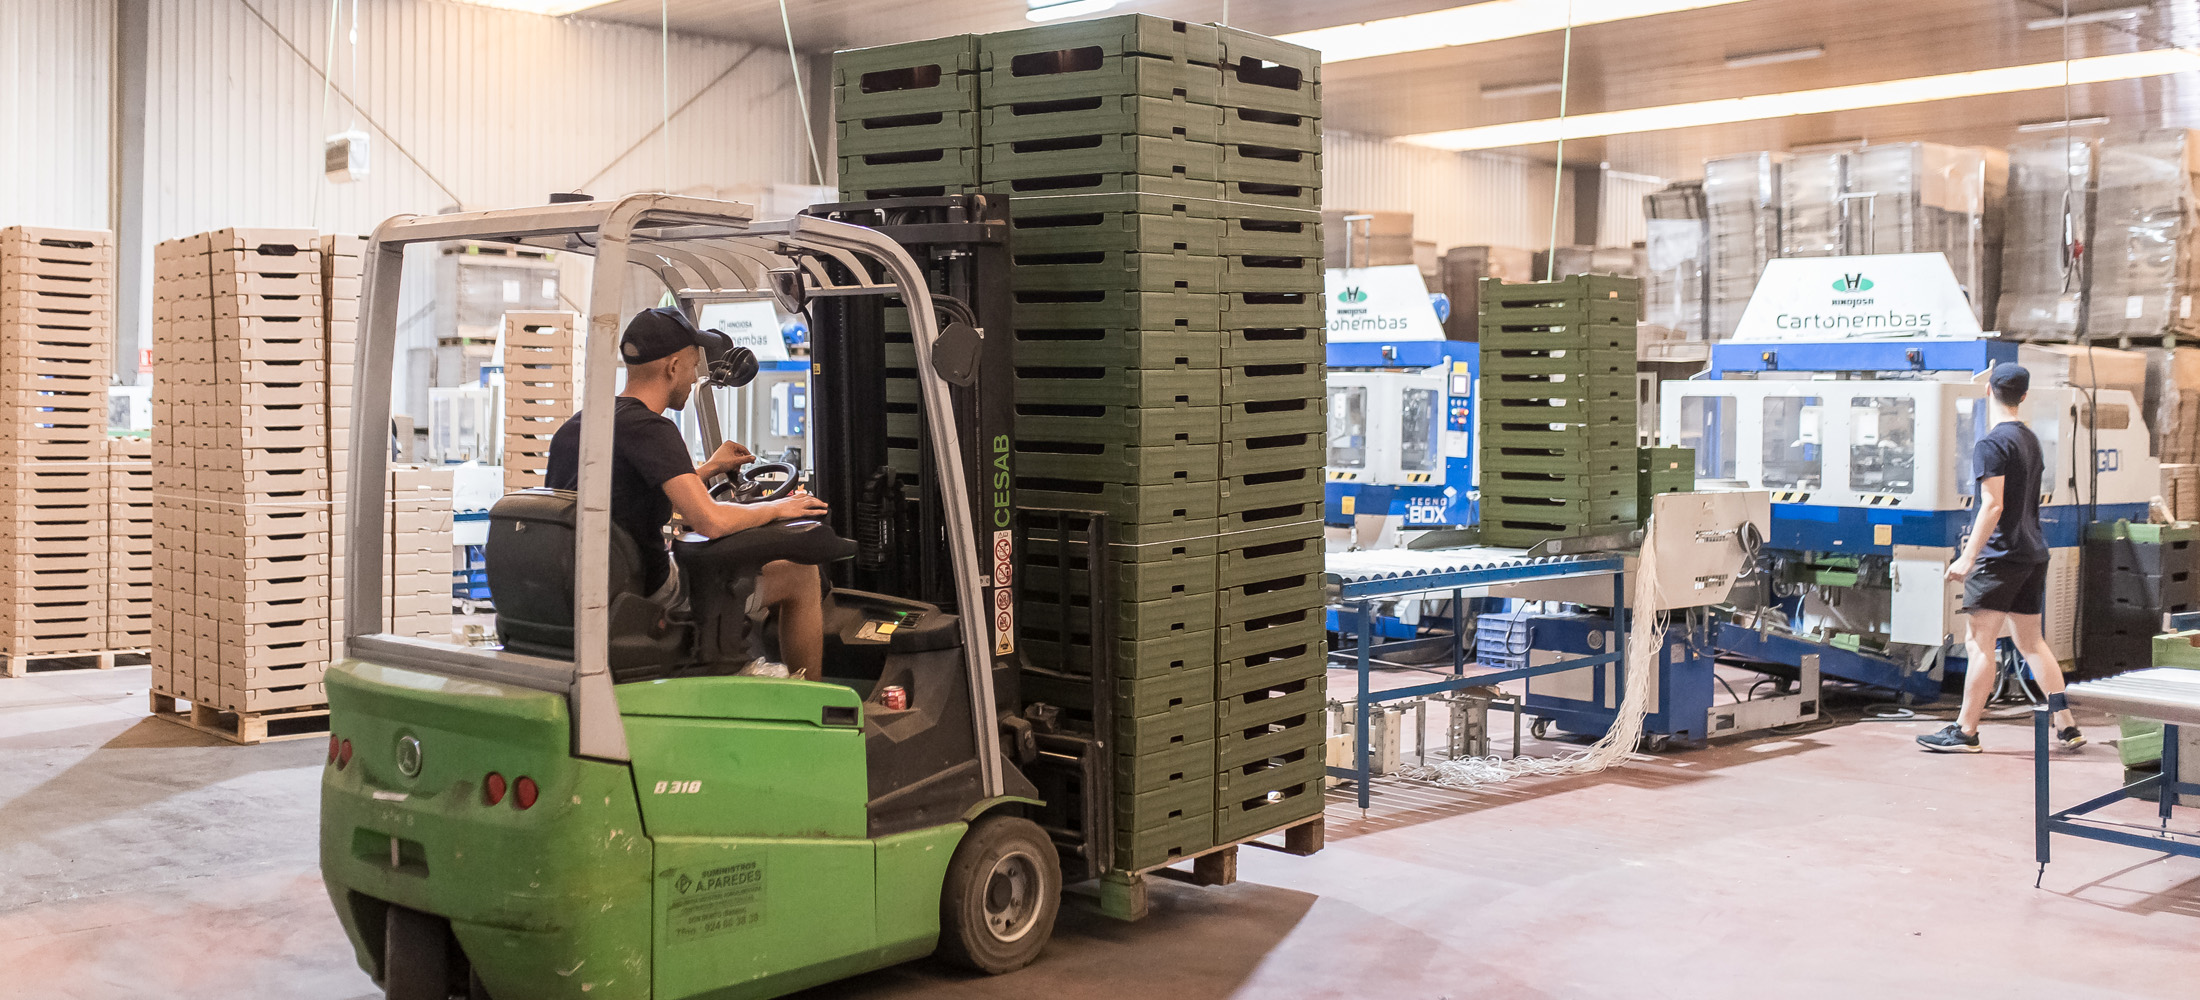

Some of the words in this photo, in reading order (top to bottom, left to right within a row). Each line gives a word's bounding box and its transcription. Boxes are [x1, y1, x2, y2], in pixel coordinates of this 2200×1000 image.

[1776, 310, 1931, 329] Cartonembas
[994, 434, 1010, 528] CESAB
[1409, 505, 1447, 523] BOX
[653, 780, 669, 794] B
[668, 780, 703, 794] 318
[702, 862, 756, 878] SUMINISTROS
[695, 870, 761, 893] A.PAREDES
